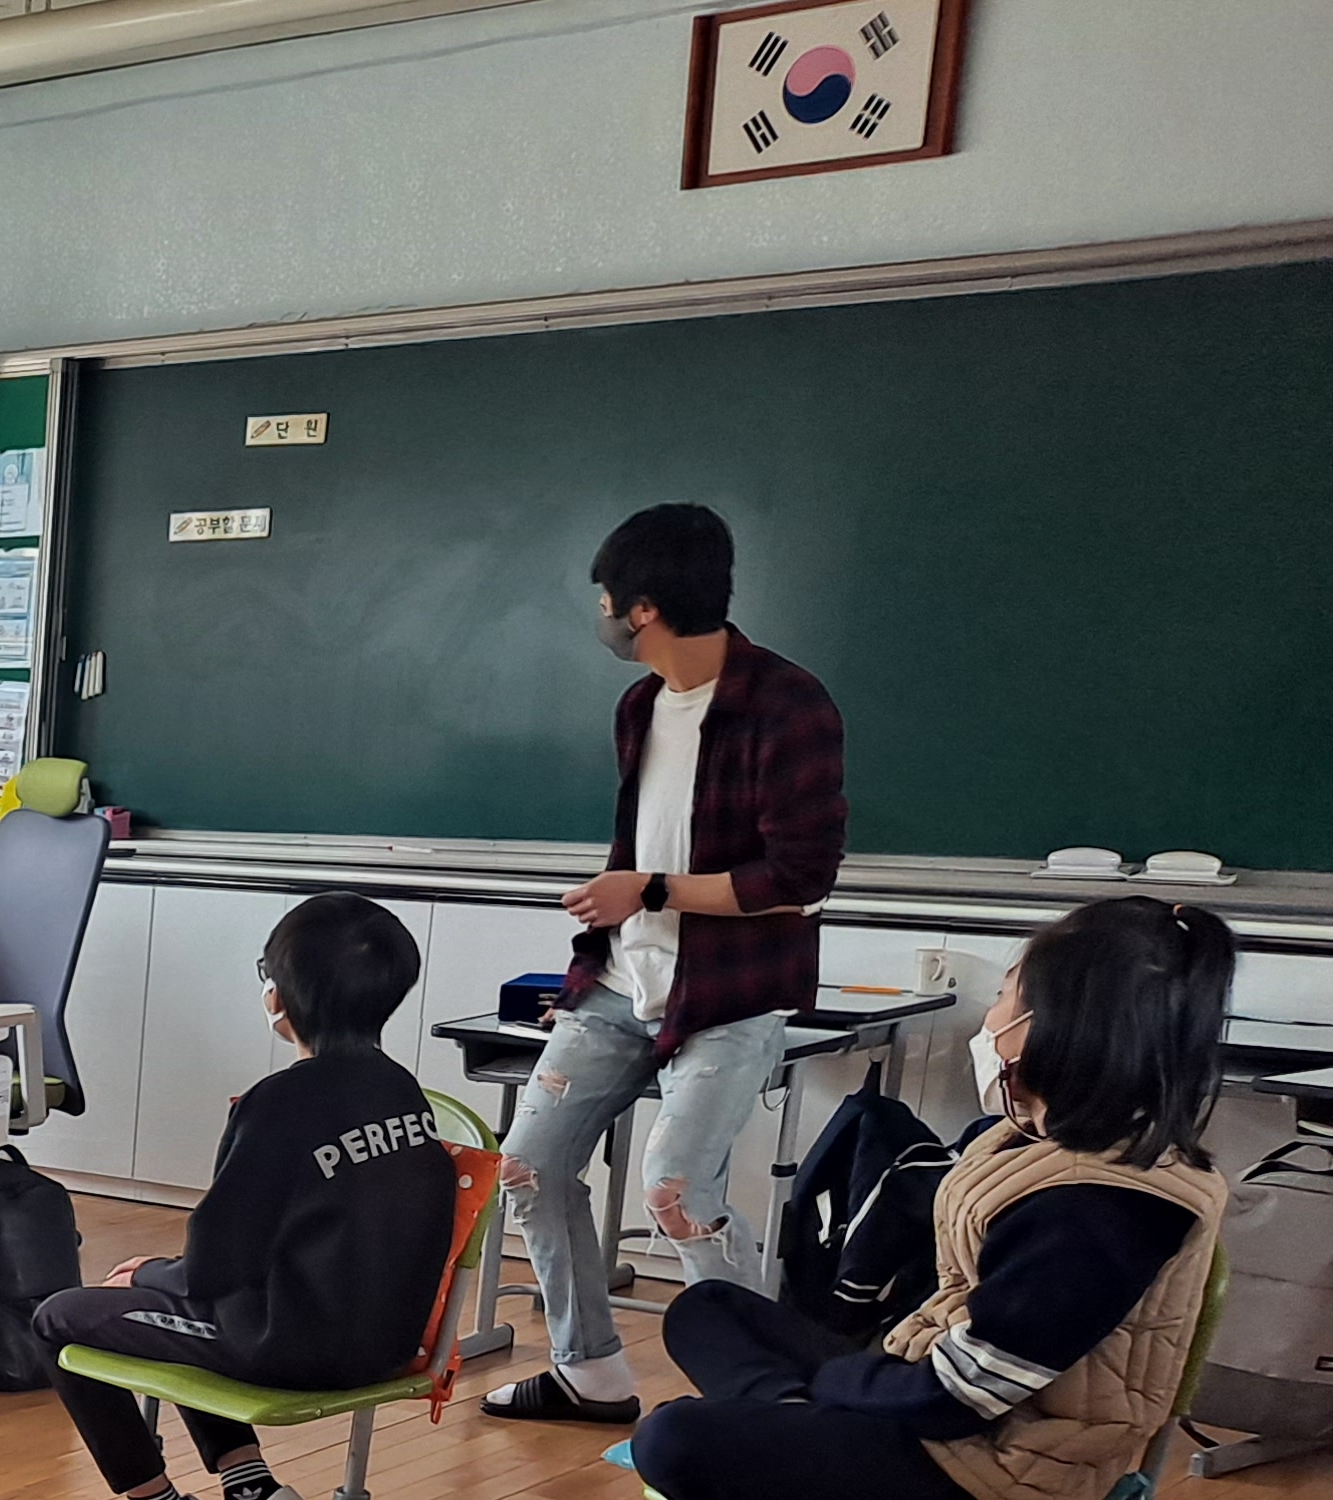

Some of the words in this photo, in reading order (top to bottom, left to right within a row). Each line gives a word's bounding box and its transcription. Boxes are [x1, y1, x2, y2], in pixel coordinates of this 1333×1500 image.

[276, 420, 290, 440] 단
[304, 419, 319, 438] 원
[194, 515, 235, 535] 공부할
